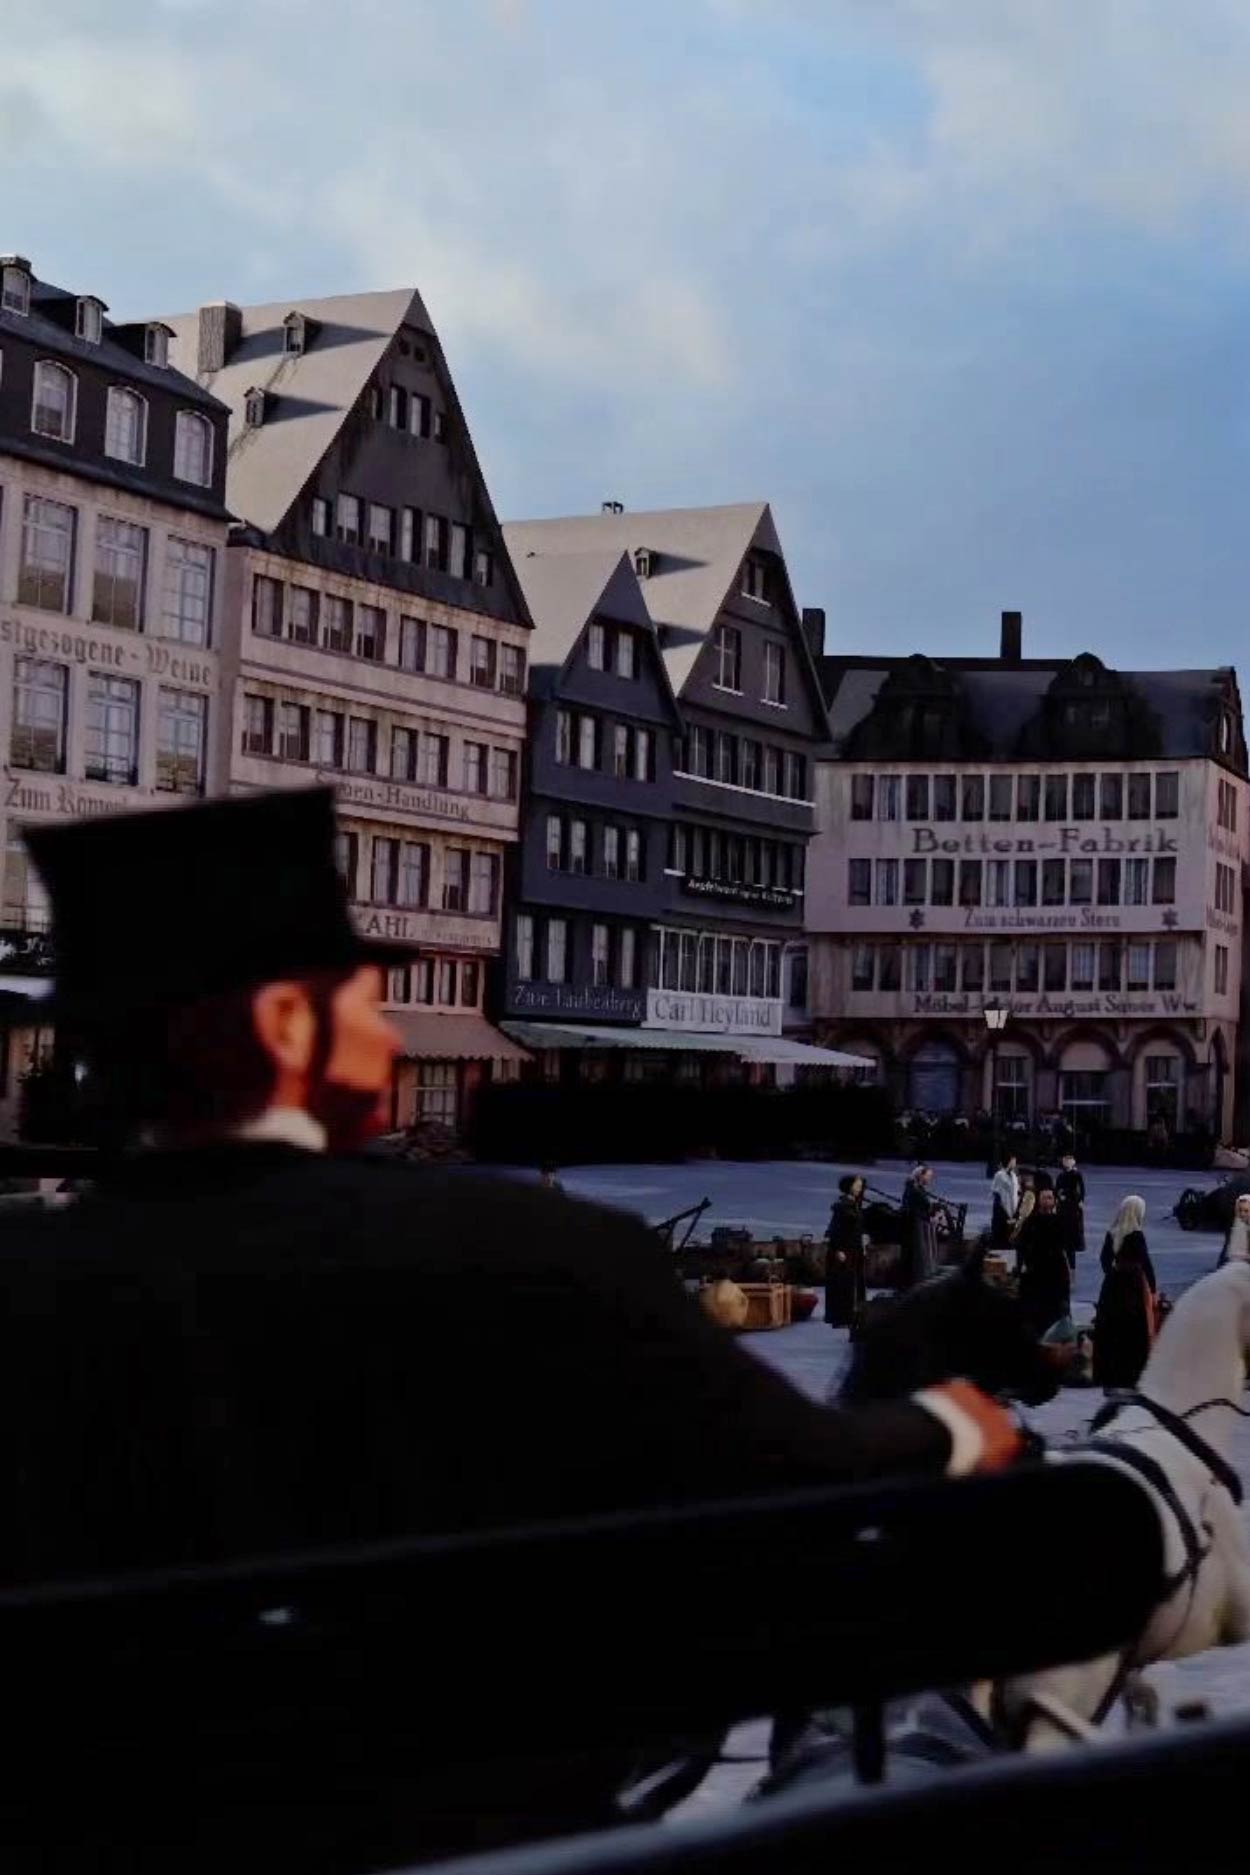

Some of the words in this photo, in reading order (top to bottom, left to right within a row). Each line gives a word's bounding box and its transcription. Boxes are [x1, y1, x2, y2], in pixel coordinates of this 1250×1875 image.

[4, 766, 50, 812] Zum
[912, 827, 1178, 853] Betten-Fabrik
[964, 907, 996, 928] Zum
[655, 993, 695, 1022] Carl
